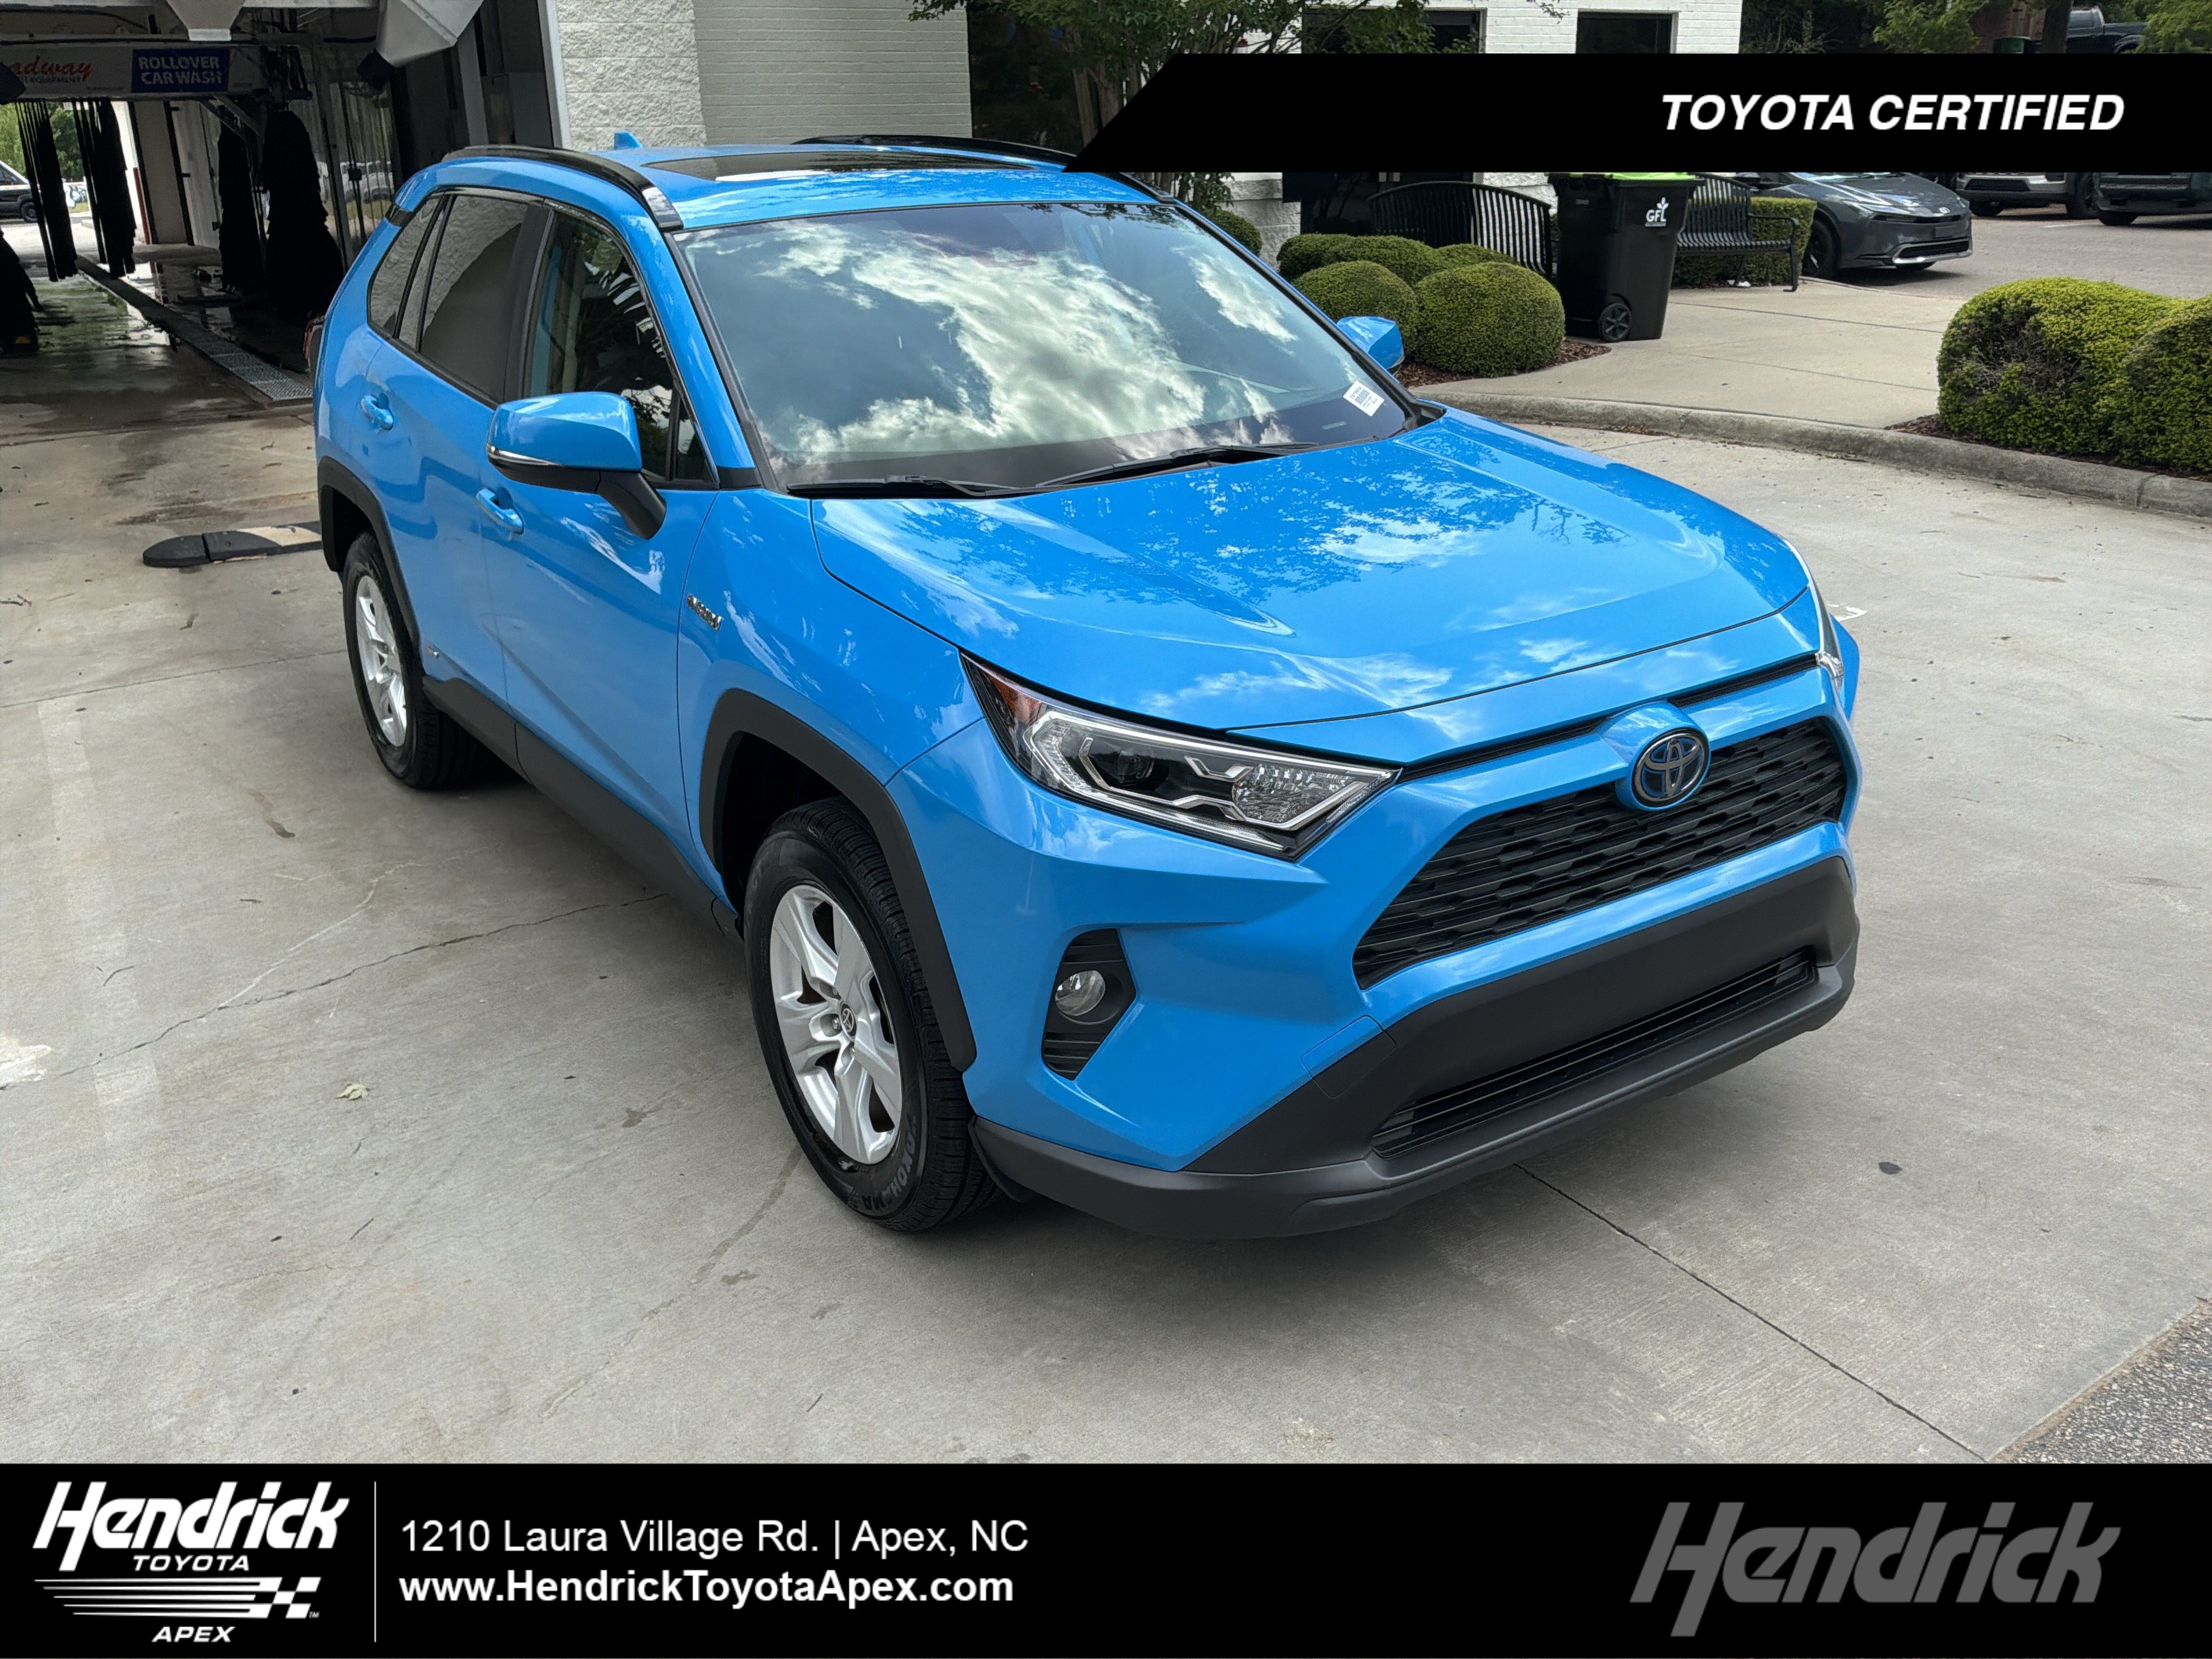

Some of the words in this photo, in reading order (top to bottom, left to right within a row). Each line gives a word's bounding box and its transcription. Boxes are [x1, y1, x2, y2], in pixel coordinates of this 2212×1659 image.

[138, 56, 219, 70] ROLLOVER
[140, 71, 174, 84] CAR
[176, 70, 222, 84] WASH
[1646, 203, 1668, 222] GFL
